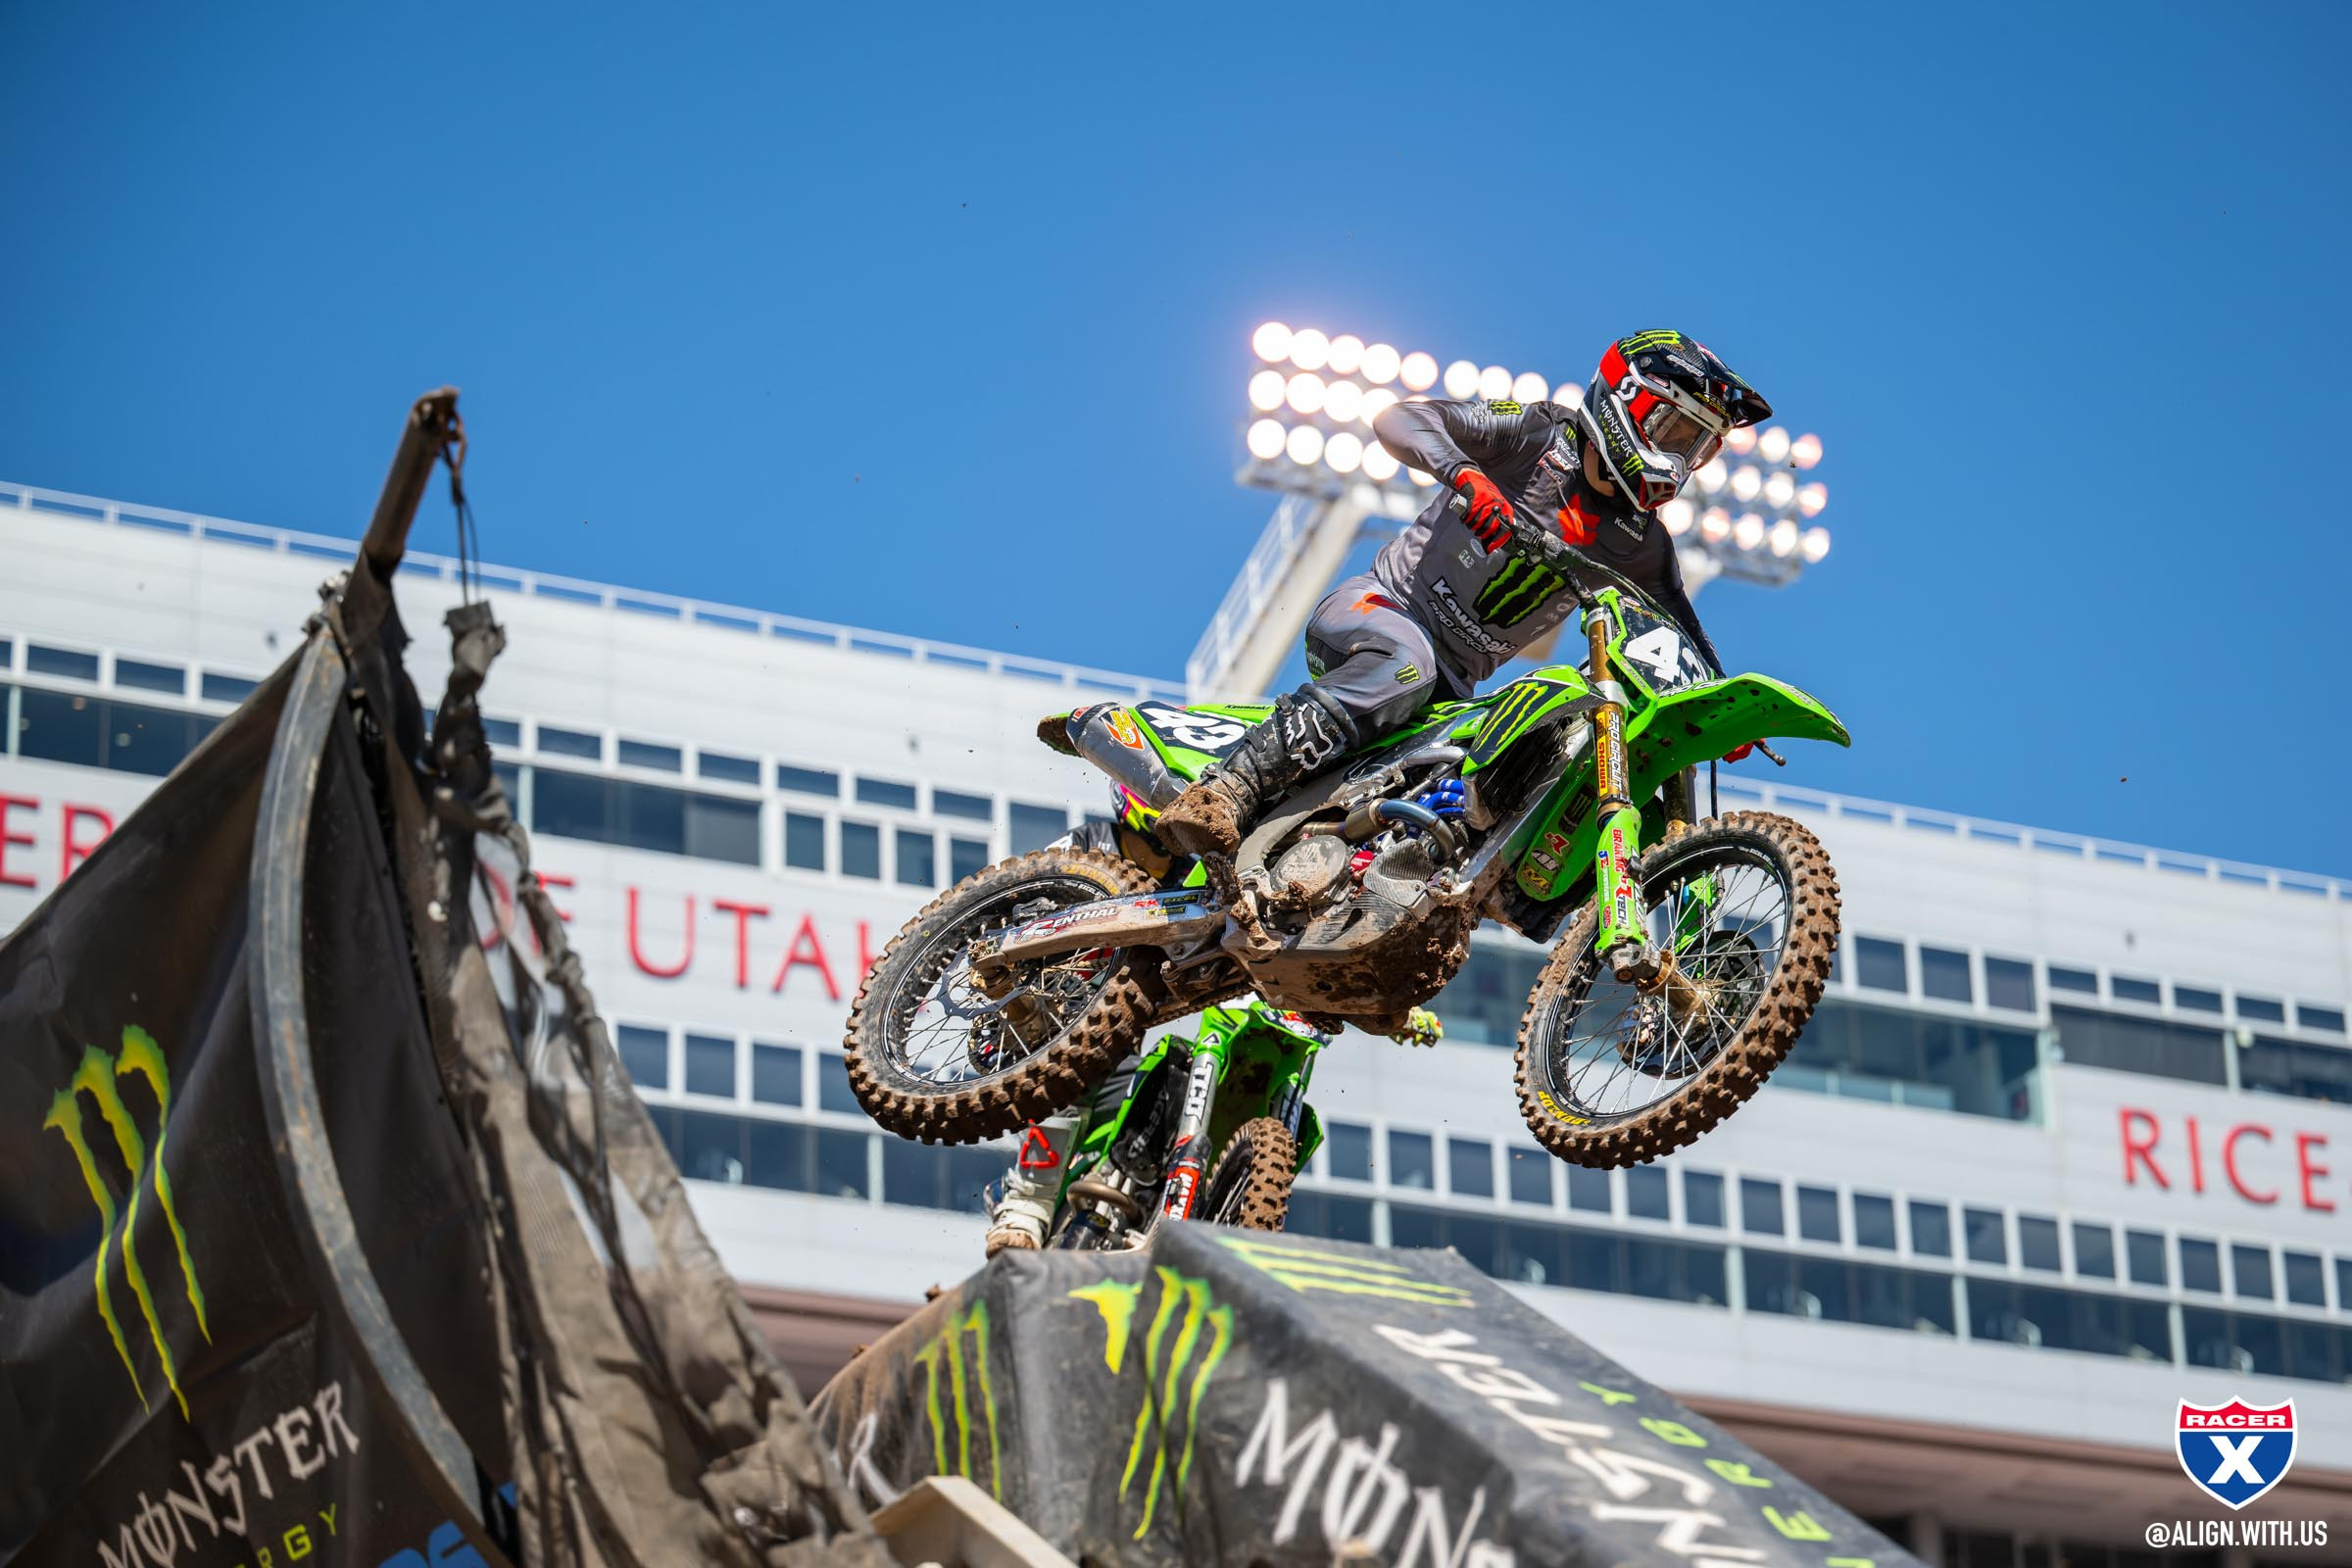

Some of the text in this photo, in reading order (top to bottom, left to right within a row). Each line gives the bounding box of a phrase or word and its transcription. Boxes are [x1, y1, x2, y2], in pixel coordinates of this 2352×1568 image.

[1429, 600, 1490, 654] PRO CIRCU
[1431, 575, 1518, 655] Kawasaki
[1142, 708, 1246, 750] 43
[1607, 711, 1624, 792] PRO CIRCUIT
[1598, 742, 1607, 789] SHOWA
[1612, 828, 1625, 873] BRAKING
[1017, 905, 1119, 942] RENTHAL
[1538, 1091, 1589, 1125] DUNLOP
